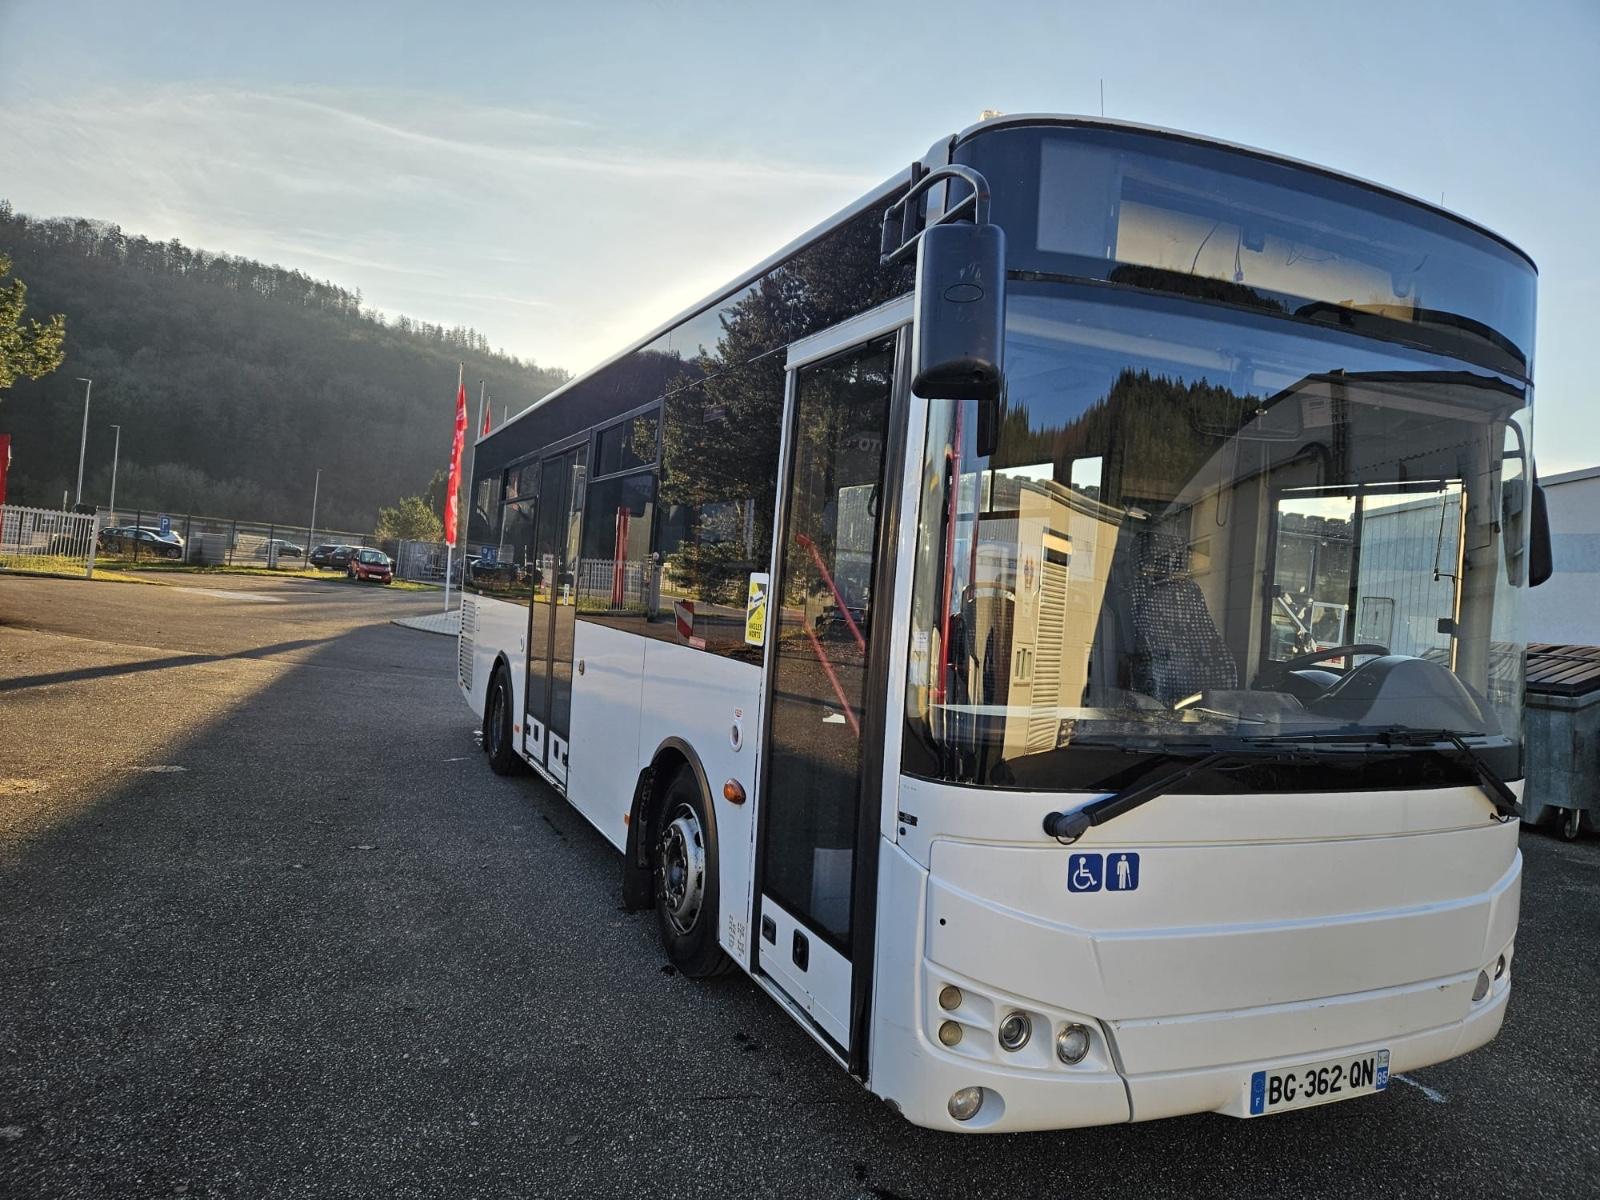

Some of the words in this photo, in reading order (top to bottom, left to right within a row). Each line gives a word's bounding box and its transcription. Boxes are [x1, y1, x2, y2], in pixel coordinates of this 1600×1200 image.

[162, 518, 169, 529] P
[1255, 1097, 1261, 1107] F
[1268, 1058, 1375, 1105] BG-362-QN
[1376, 1070, 1388, 1086] 85
